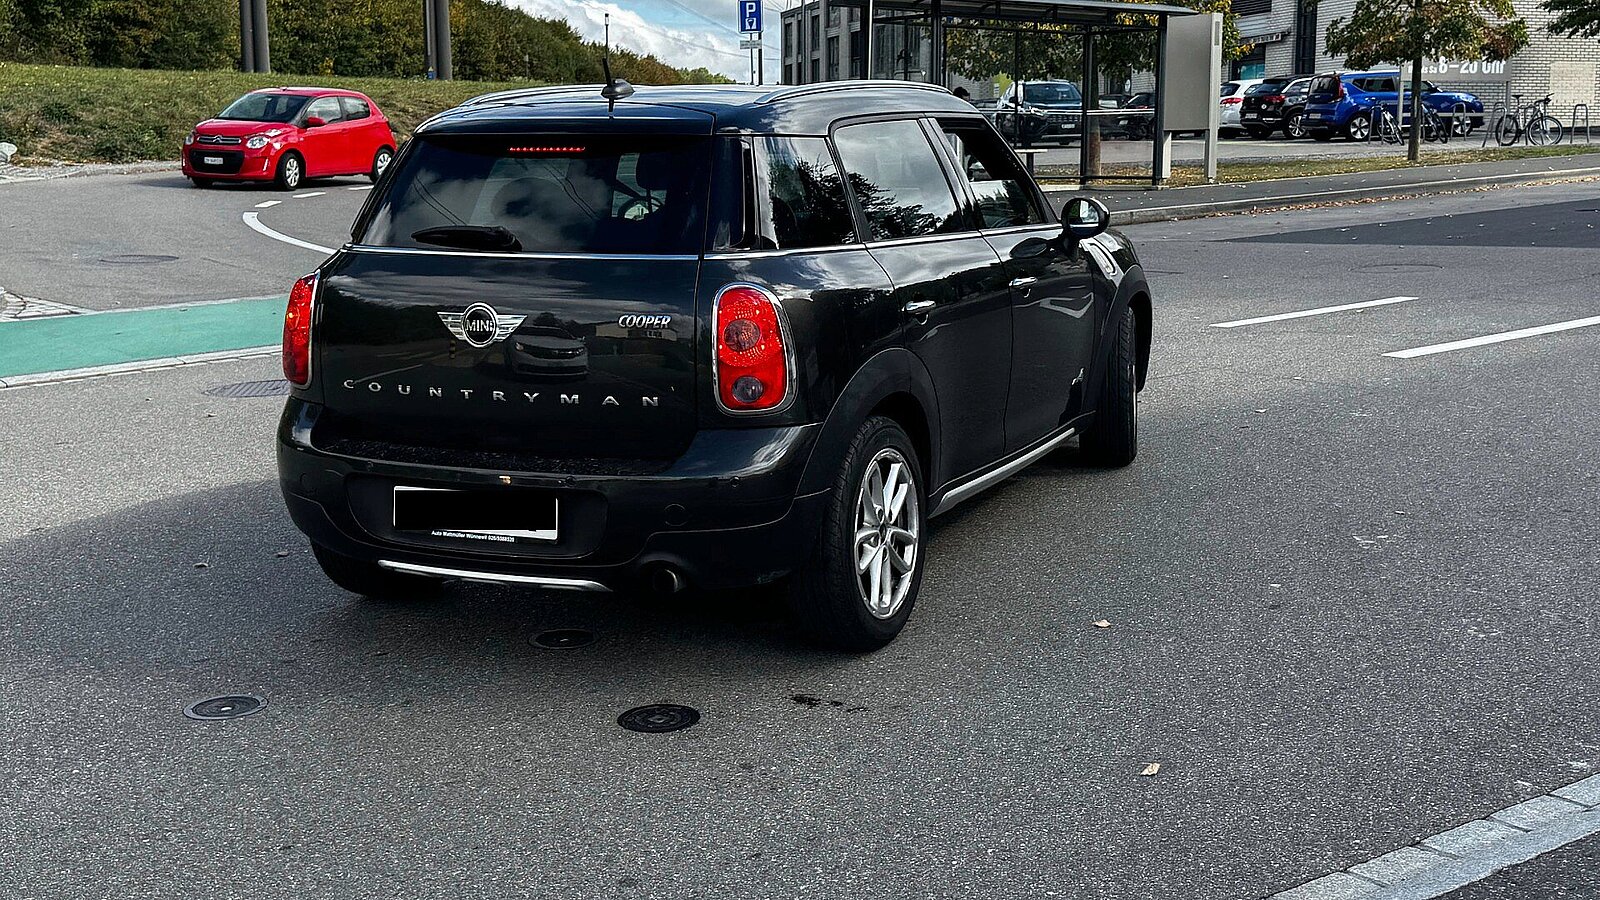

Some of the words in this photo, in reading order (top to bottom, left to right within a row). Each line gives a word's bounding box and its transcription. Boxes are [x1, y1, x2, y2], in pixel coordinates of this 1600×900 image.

[746, 2, 756, 17] P
[1482, 59, 1506, 74] Uhr
[466, 319, 494, 332] MINI
[618, 314, 671, 329] COOPER
[343, 379, 660, 407] COUNTRYMAN
